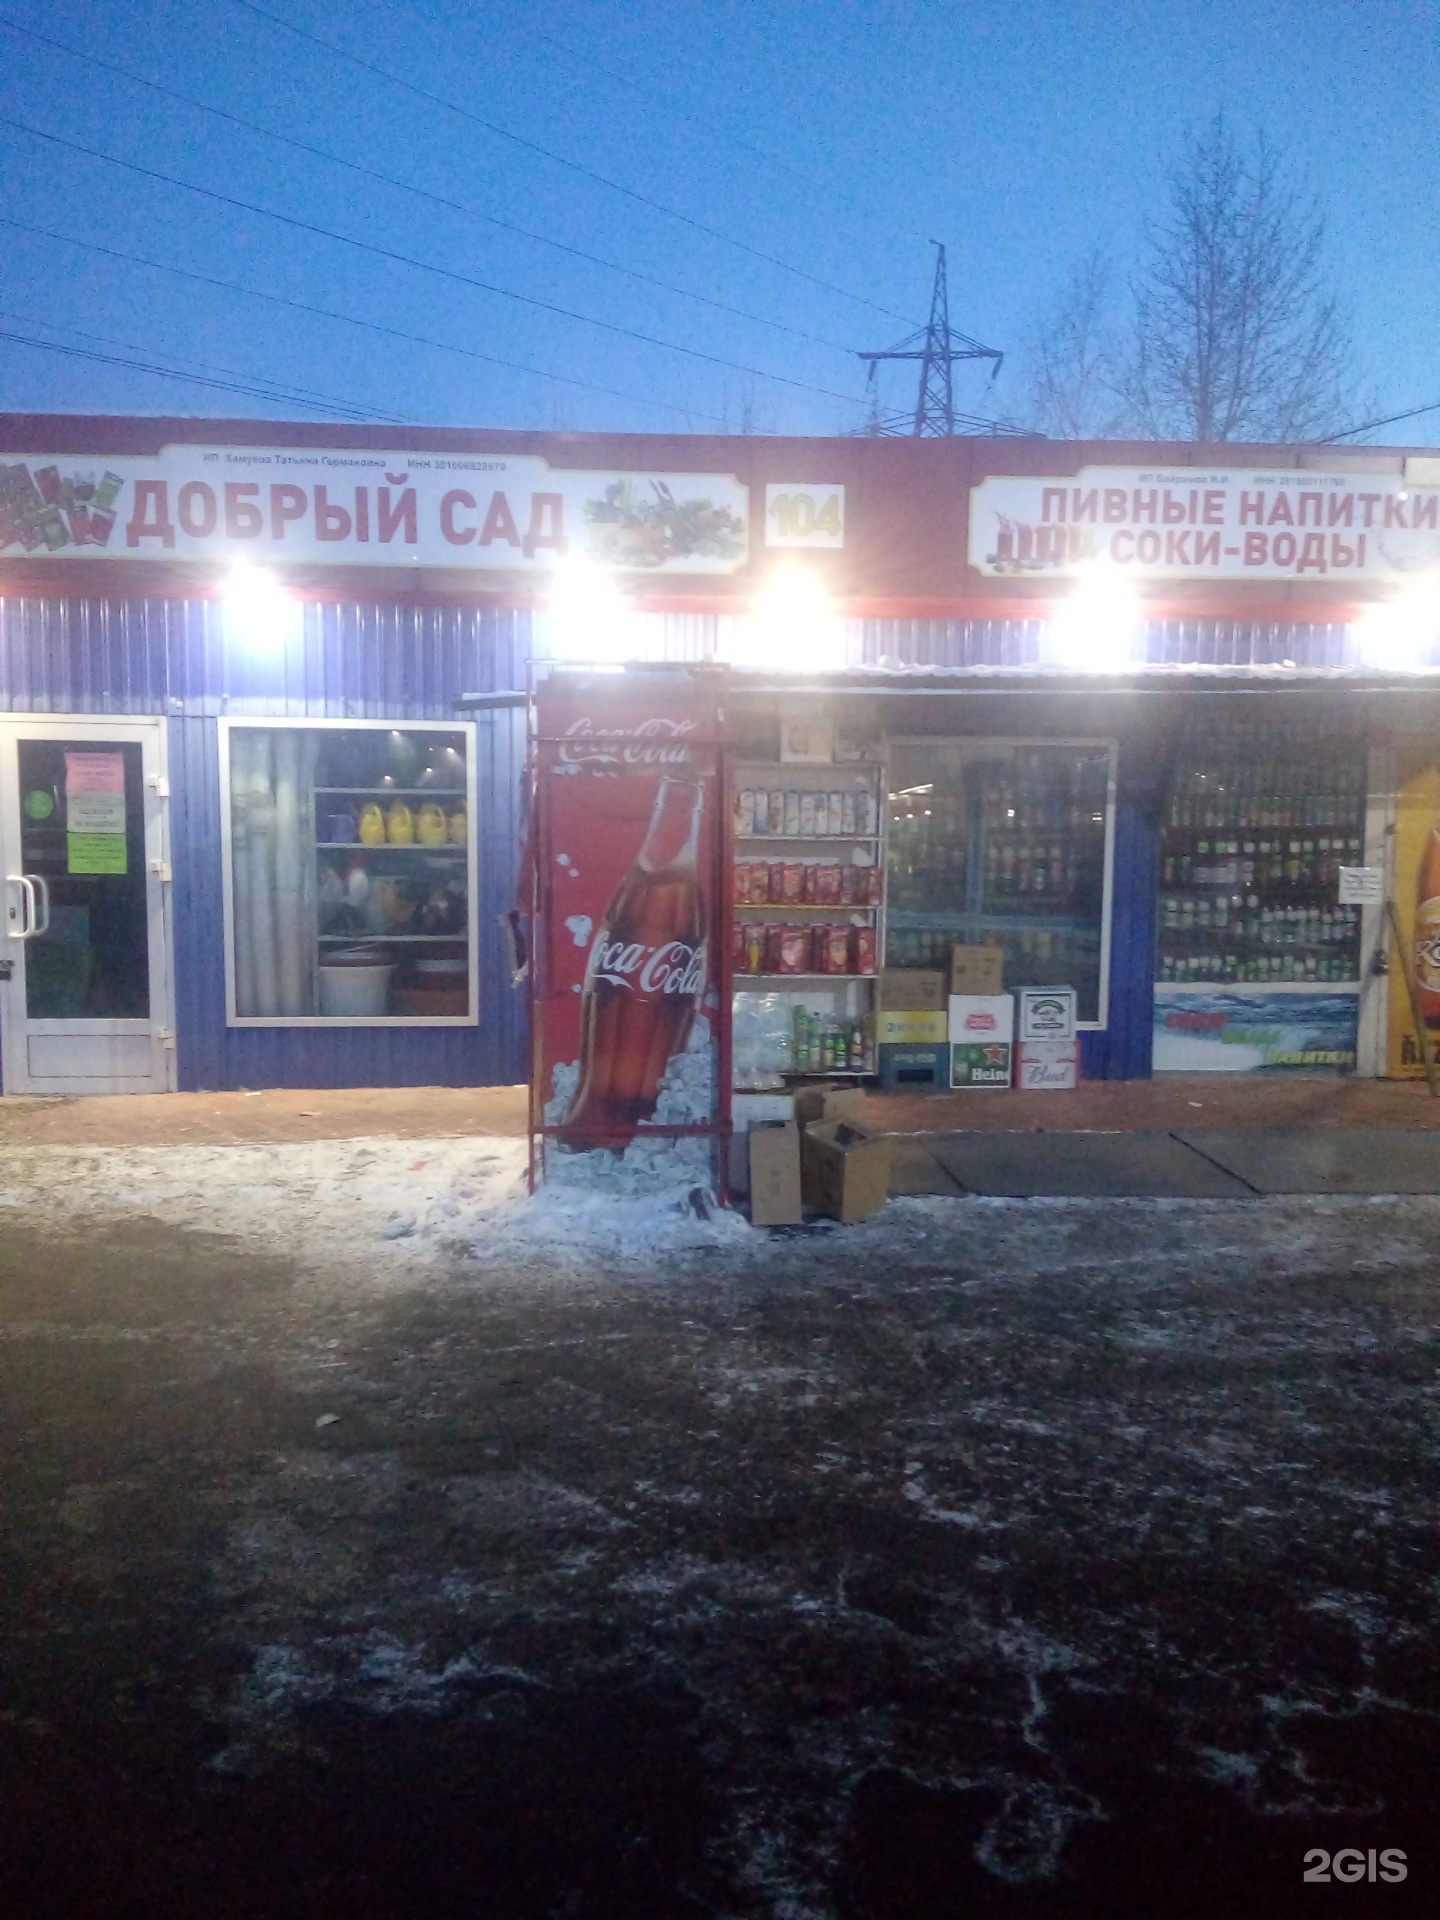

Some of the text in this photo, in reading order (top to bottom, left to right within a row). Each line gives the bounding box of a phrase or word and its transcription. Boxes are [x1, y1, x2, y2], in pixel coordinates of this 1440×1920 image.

[274, 454, 318, 466] Татьяна
[407, 458, 431, 468] ИНН
[126, 472, 569, 558] ДОБРЫЙ САД
[767, 492, 843, 537] 104
[1041, 488, 1438, 530] ПИВНЫЕ НАПИТКИ
[1109, 529, 1366, 574] СОКИ-ВОДЫ
